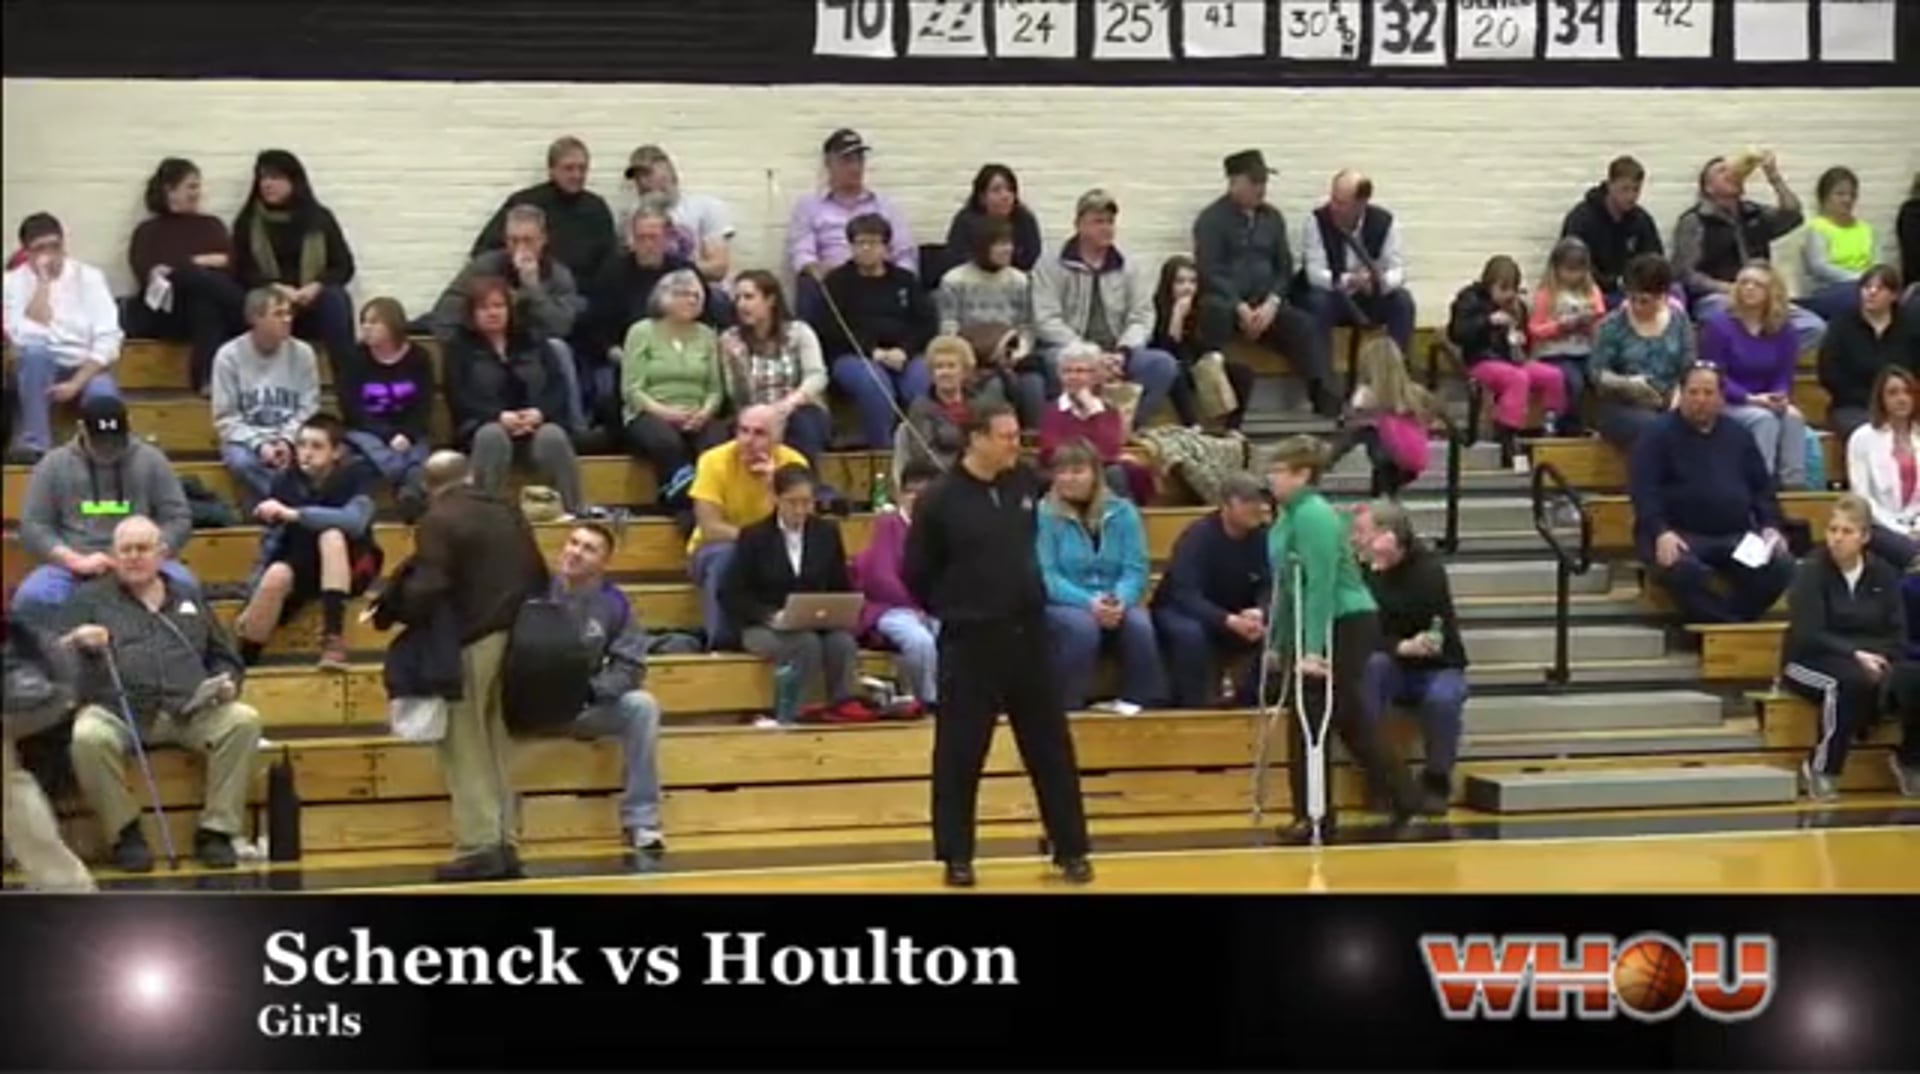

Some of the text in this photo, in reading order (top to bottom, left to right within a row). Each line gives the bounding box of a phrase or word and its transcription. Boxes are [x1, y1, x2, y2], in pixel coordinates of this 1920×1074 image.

[1012, 11, 1055, 43] 24
[1103, 0, 1153, 43] 25
[1205, 3, 1236, 28] 41
[1288, 10, 1326, 38] 30
[1381, 0, 1437, 54] 32
[1472, 14, 1519, 48] 20
[1554, 0, 1604, 45] 34
